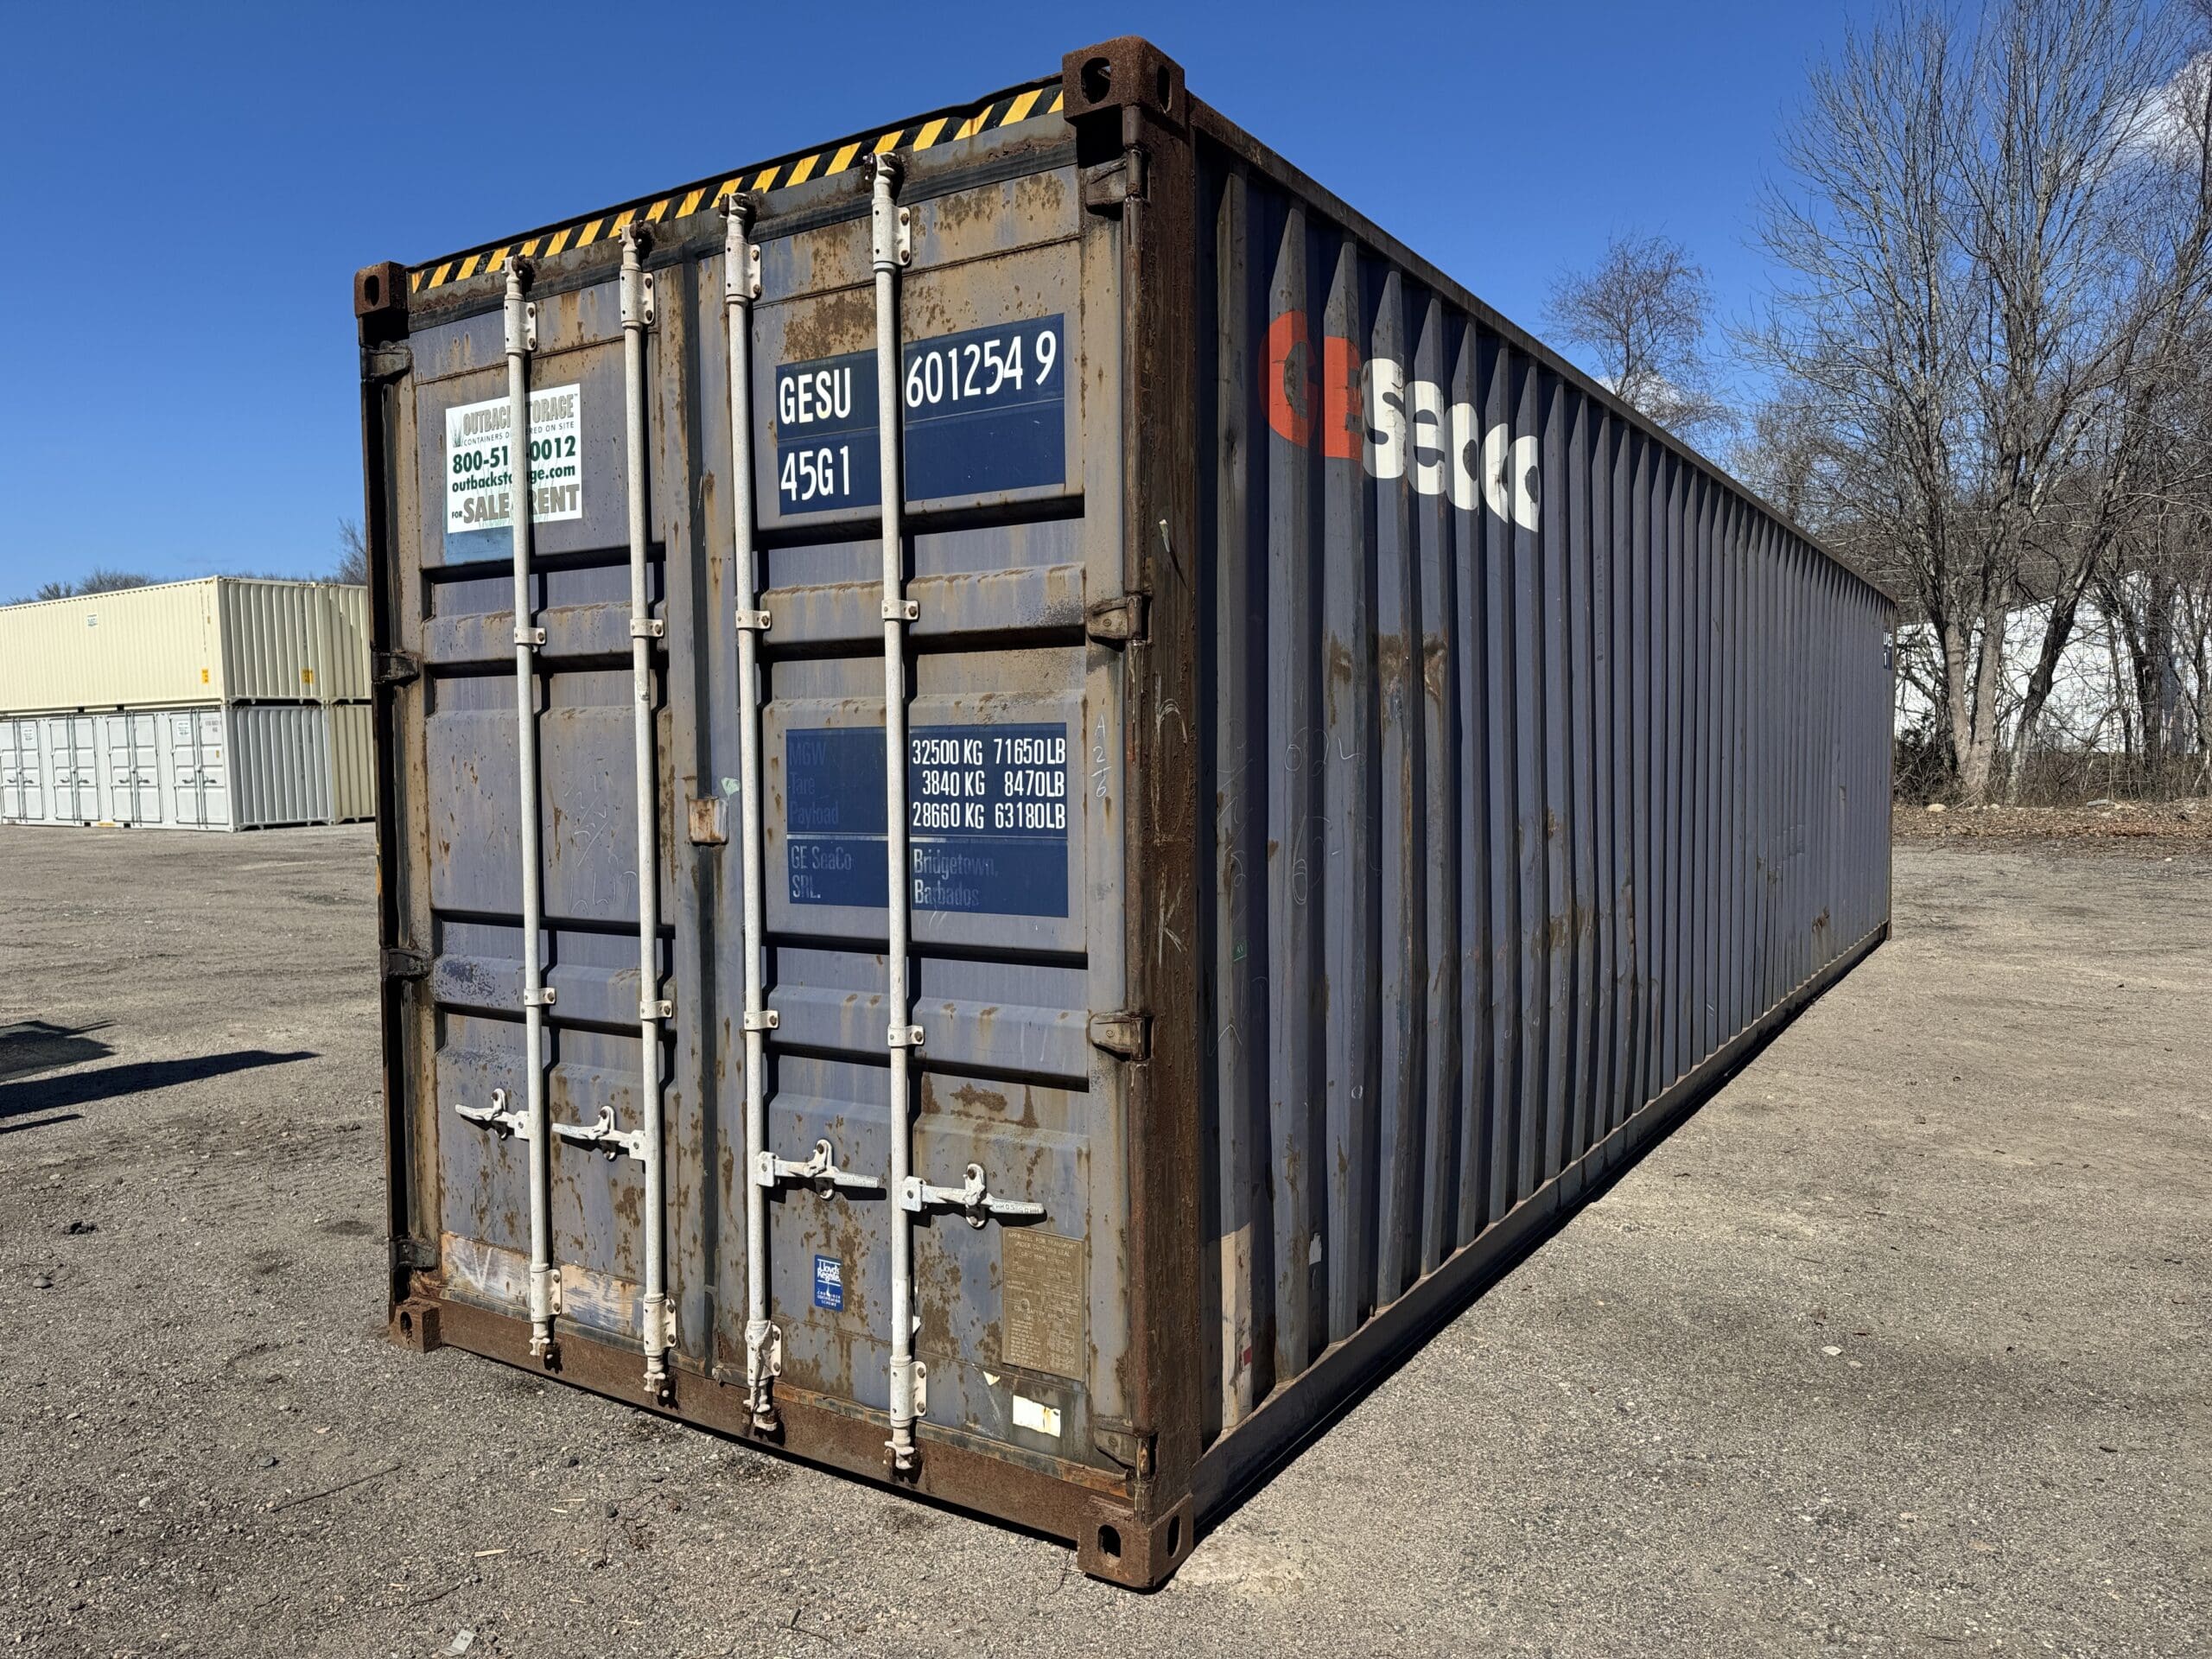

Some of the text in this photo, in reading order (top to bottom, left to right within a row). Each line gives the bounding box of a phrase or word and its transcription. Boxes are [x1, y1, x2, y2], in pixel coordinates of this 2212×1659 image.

[779, 330, 1058, 425] GESU 601254 9
[464, 432, 503, 447] CONTAINERS
[545, 424, 556, 433] ON
[559, 421, 575, 430] SITE
[452, 435, 576, 474] 800-51-0012
[780, 445, 850, 501] 45G1
[451, 511, 463, 519] FOR
[463, 493, 510, 524] SALE
[912, 739, 959, 765] 32500
[963, 739, 983, 766] KG
[789, 772, 816, 795] Tare
[922, 771, 960, 797] 3840
[964, 770, 985, 797] KG
[790, 800, 839, 830] Payload
[912, 802, 960, 829] 28660
[964, 802, 985, 830] KG
[791, 844, 852, 870] GE SeaCo
[914, 879, 979, 906] Barbados
